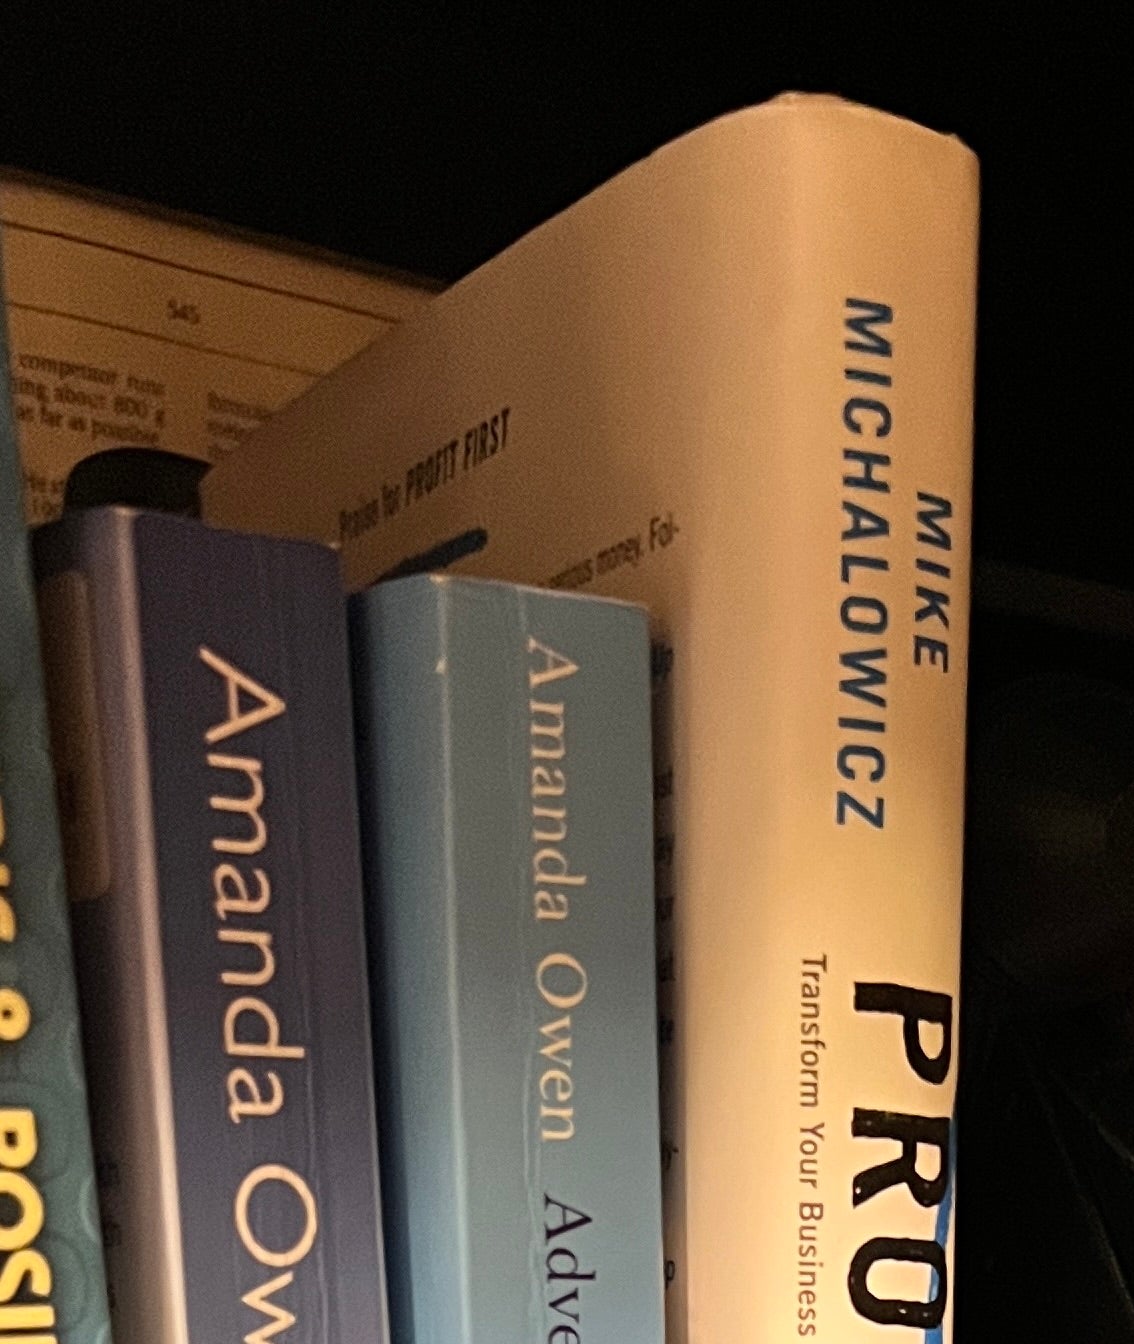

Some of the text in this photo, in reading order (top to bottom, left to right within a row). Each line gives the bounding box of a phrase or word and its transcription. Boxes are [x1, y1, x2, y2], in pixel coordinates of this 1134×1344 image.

[405, 438, 459, 507] PROFIT
[463, 406, 511, 471] FIRST
[835, 297, 894, 829] MICHALOWICZ
[913, 491, 953, 673] MIKE
[526, 635, 588, 923] Amanda
[199, 644, 306, 1125] Amanda
[536, 951, 589, 1144] Owen
[799, 953, 828, 1107] Transform
[798, 1121, 826, 1190] Your
[797, 1202, 825, 1337] Business
